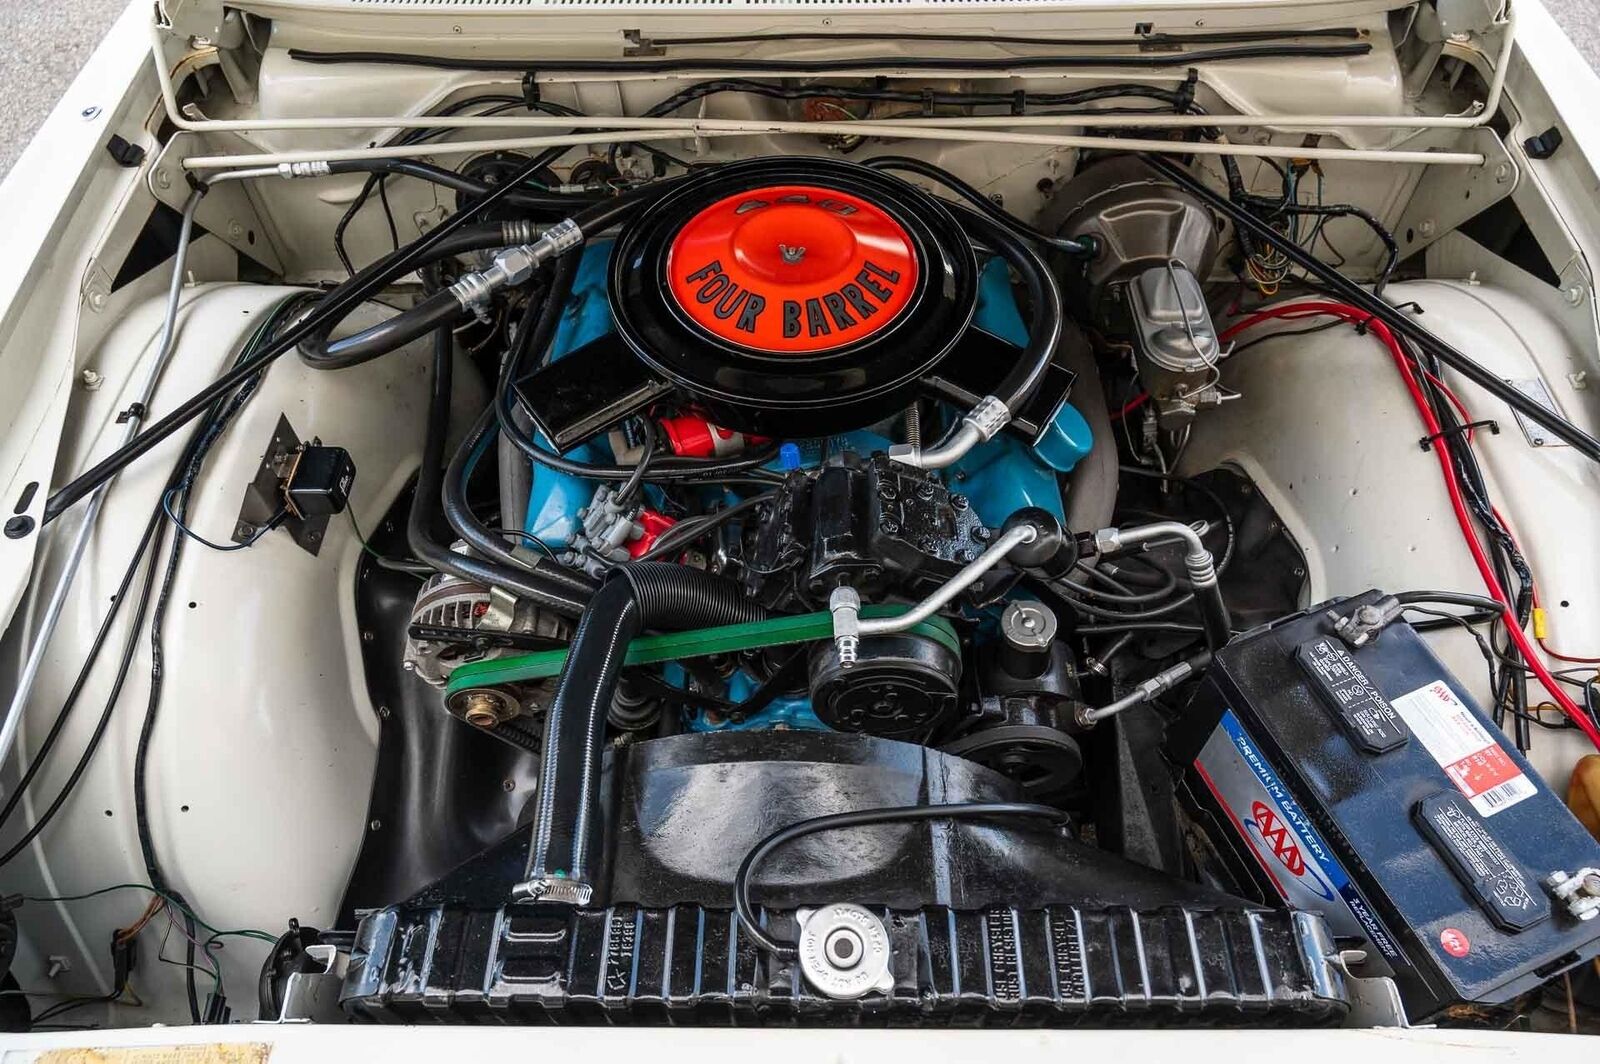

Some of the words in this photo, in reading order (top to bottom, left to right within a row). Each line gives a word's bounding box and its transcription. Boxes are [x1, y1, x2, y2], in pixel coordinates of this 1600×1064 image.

[686, 260, 766, 334] FOUR
[782, 261, 901, 339] BARREL
[1343, 655, 1369, 686] DANGER
[1371, 691, 1397, 720] POISON
[1237, 736, 1284, 798] PREMIUM
[1283, 799, 1330, 863] BATTERY
[1254, 803, 1304, 876] AAA
[989, 909, 1004, 972] CHRYSLER
[1001, 909, 1017, 965] RESISTOR
[1350, 901, 1393, 958] REPLACEMENT
[1358, 904, 1377, 930] YEAR
[1375, 927, 1398, 958] FREE
[1007, 971, 1020, 1000] RUST
